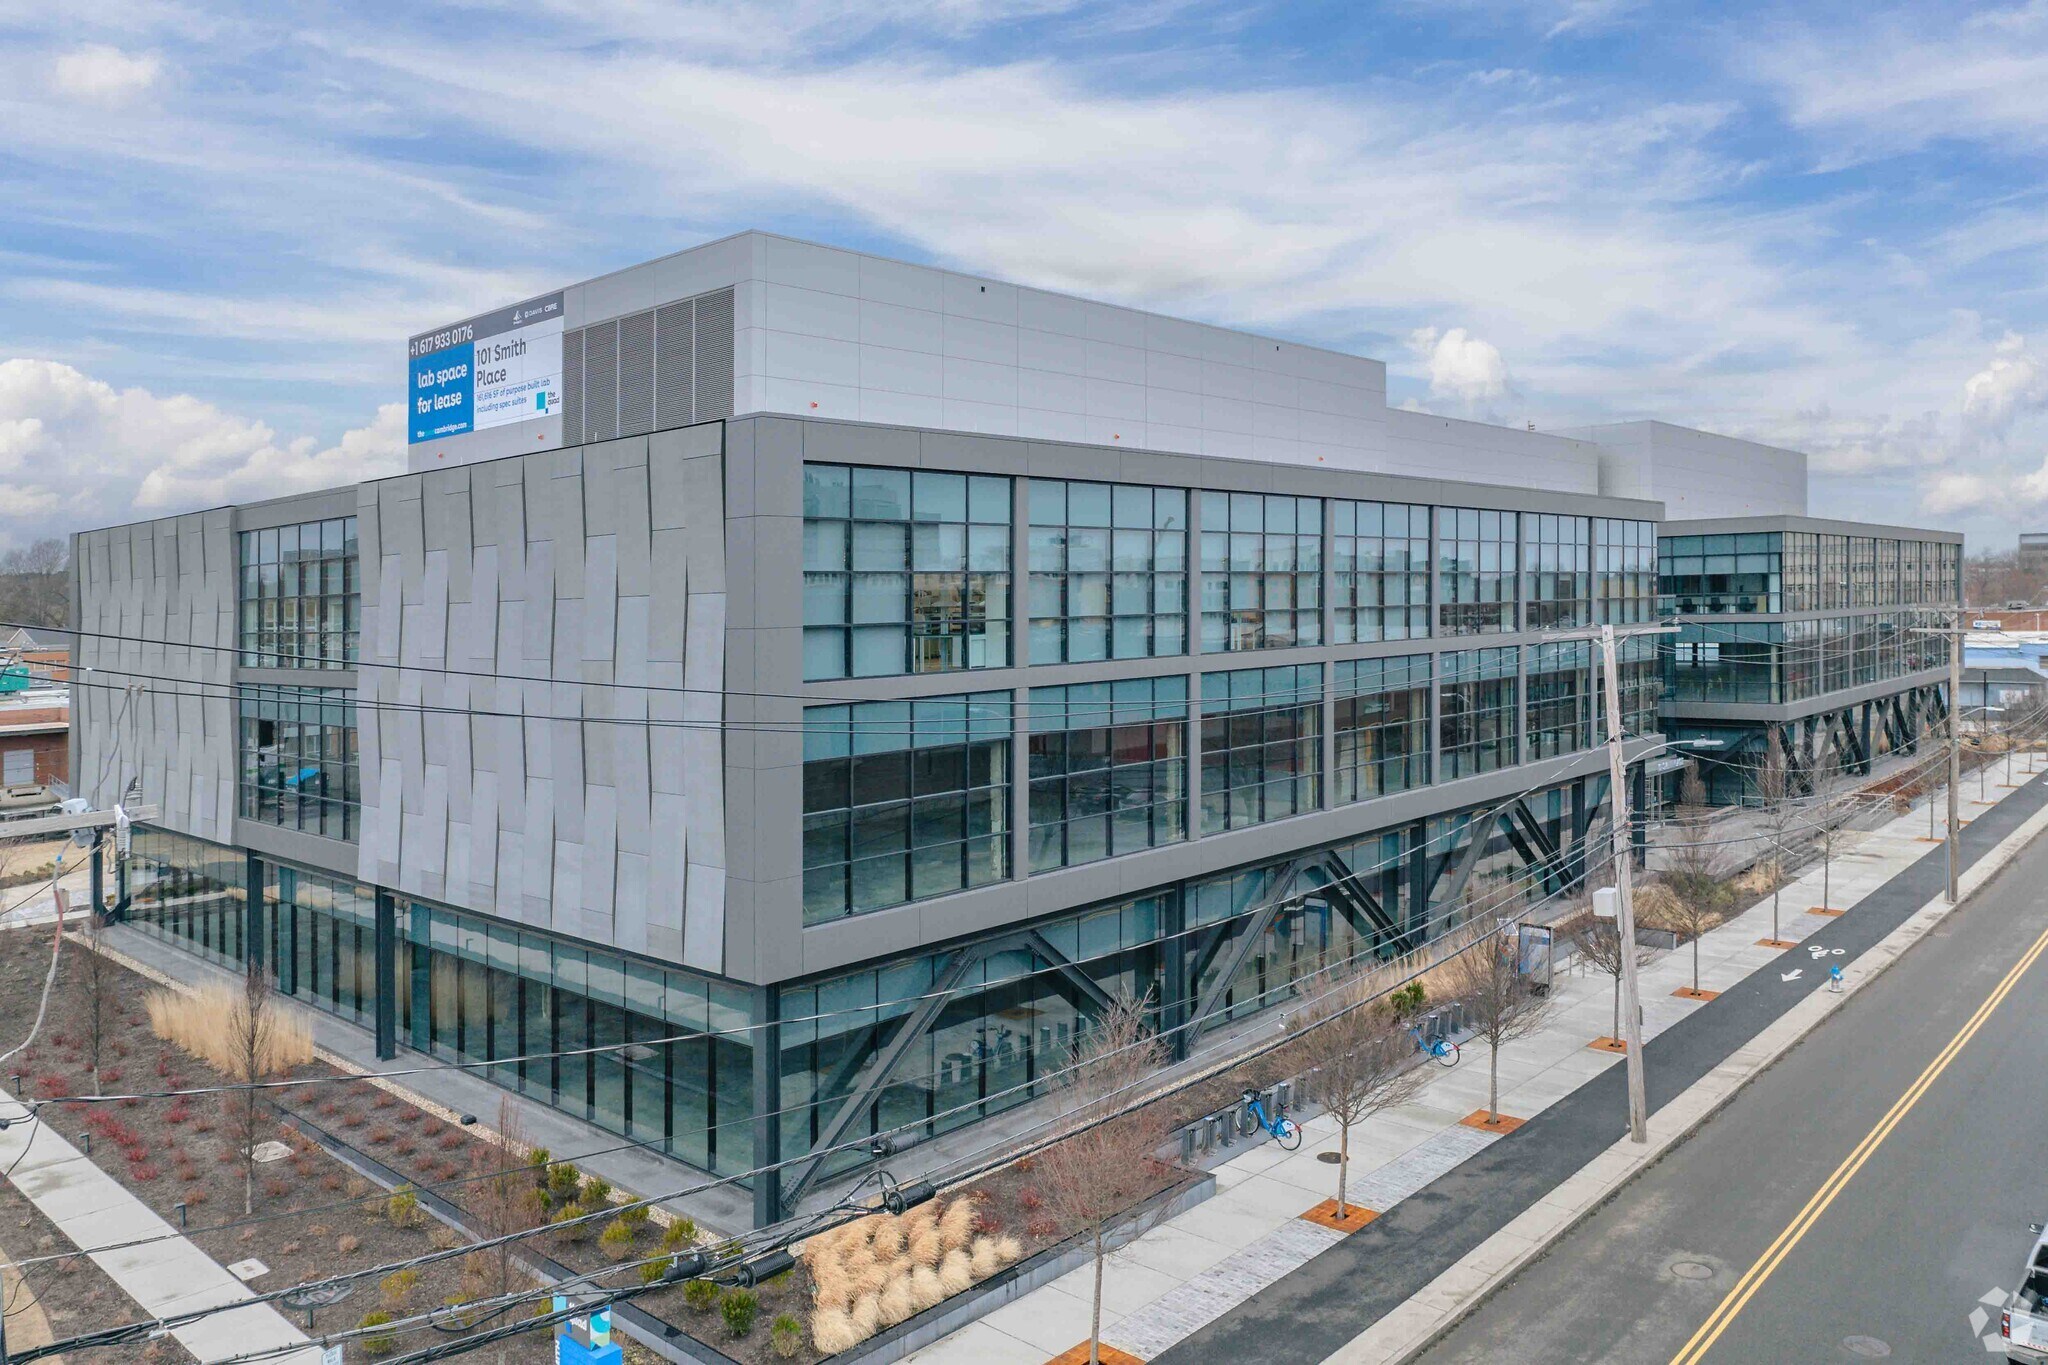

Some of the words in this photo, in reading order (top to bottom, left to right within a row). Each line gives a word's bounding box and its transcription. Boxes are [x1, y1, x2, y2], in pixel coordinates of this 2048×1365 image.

[410, 341, 418, 356] +1
[420, 337, 434, 354] 617
[434, 331, 451, 350] 933
[452, 324, 473, 344] 0176
[476, 347, 491, 367] 101
[494, 338, 526, 361] Smith
[418, 369, 435, 388] lab
[436, 364, 468, 388] space
[476, 368, 507, 387] Place
[418, 397, 432, 414] for
[434, 392, 462, 410] lease
